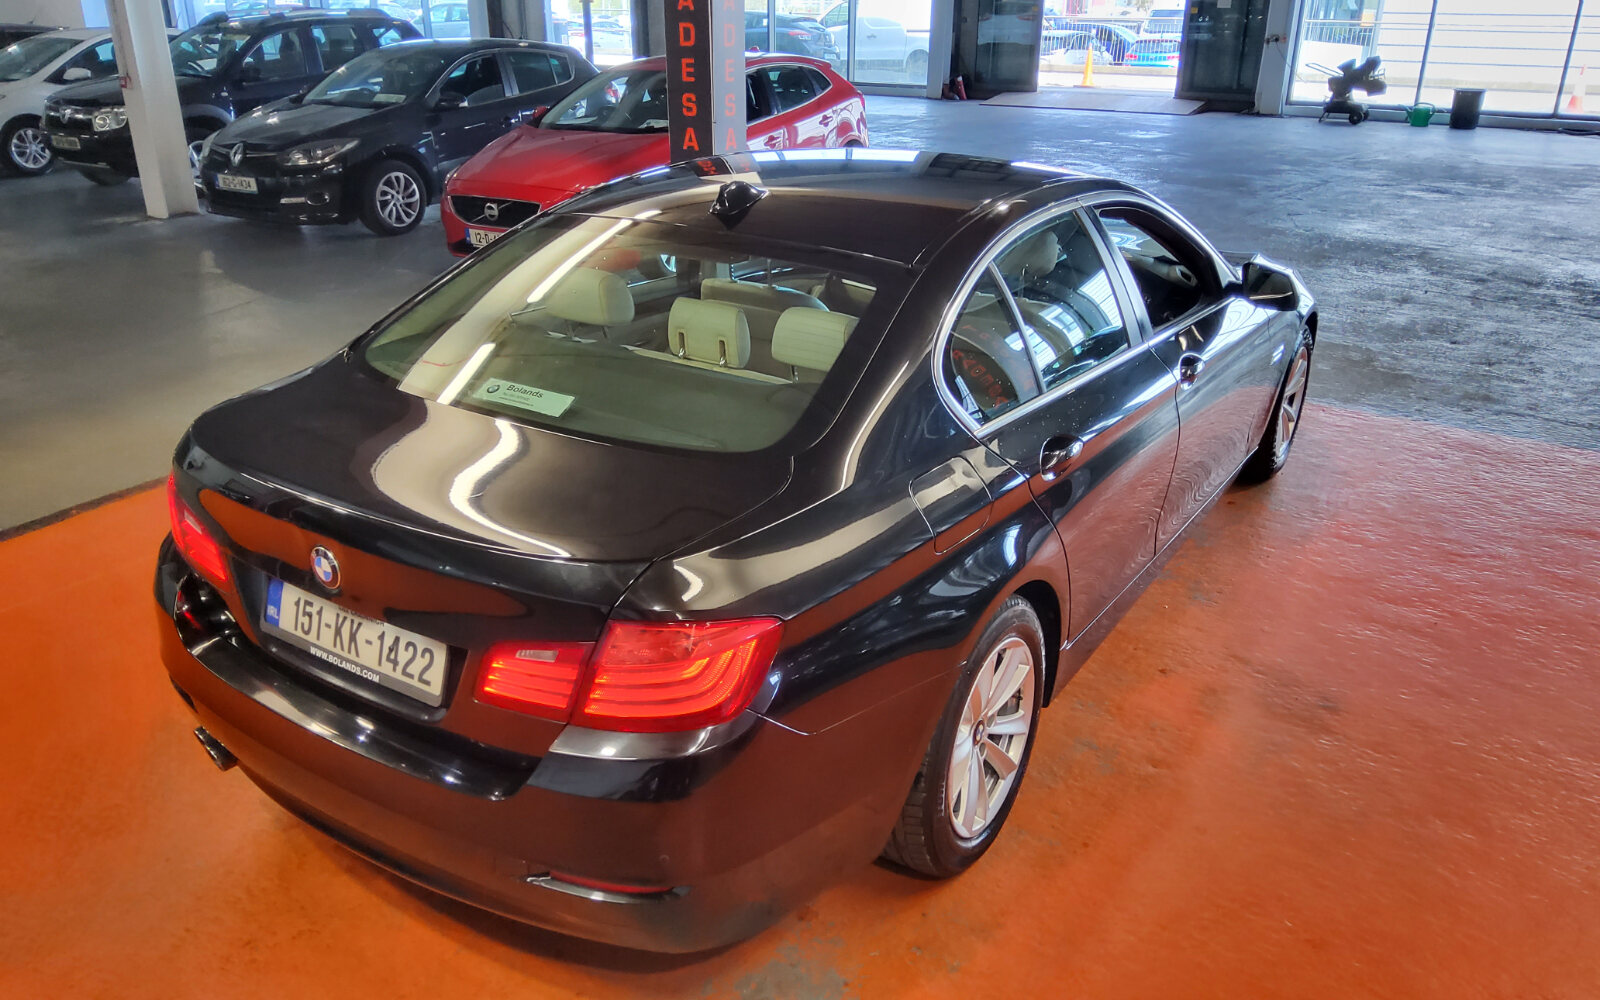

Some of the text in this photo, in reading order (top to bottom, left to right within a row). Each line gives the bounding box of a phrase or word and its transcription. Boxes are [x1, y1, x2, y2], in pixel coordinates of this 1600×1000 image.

[507, 384, 543, 398] Bolands
[267, 605, 279, 619] IRL
[294, 596, 435, 687] 151-KK-1422
[310, 645, 380, 683] WWW.BOLANDS.COM
